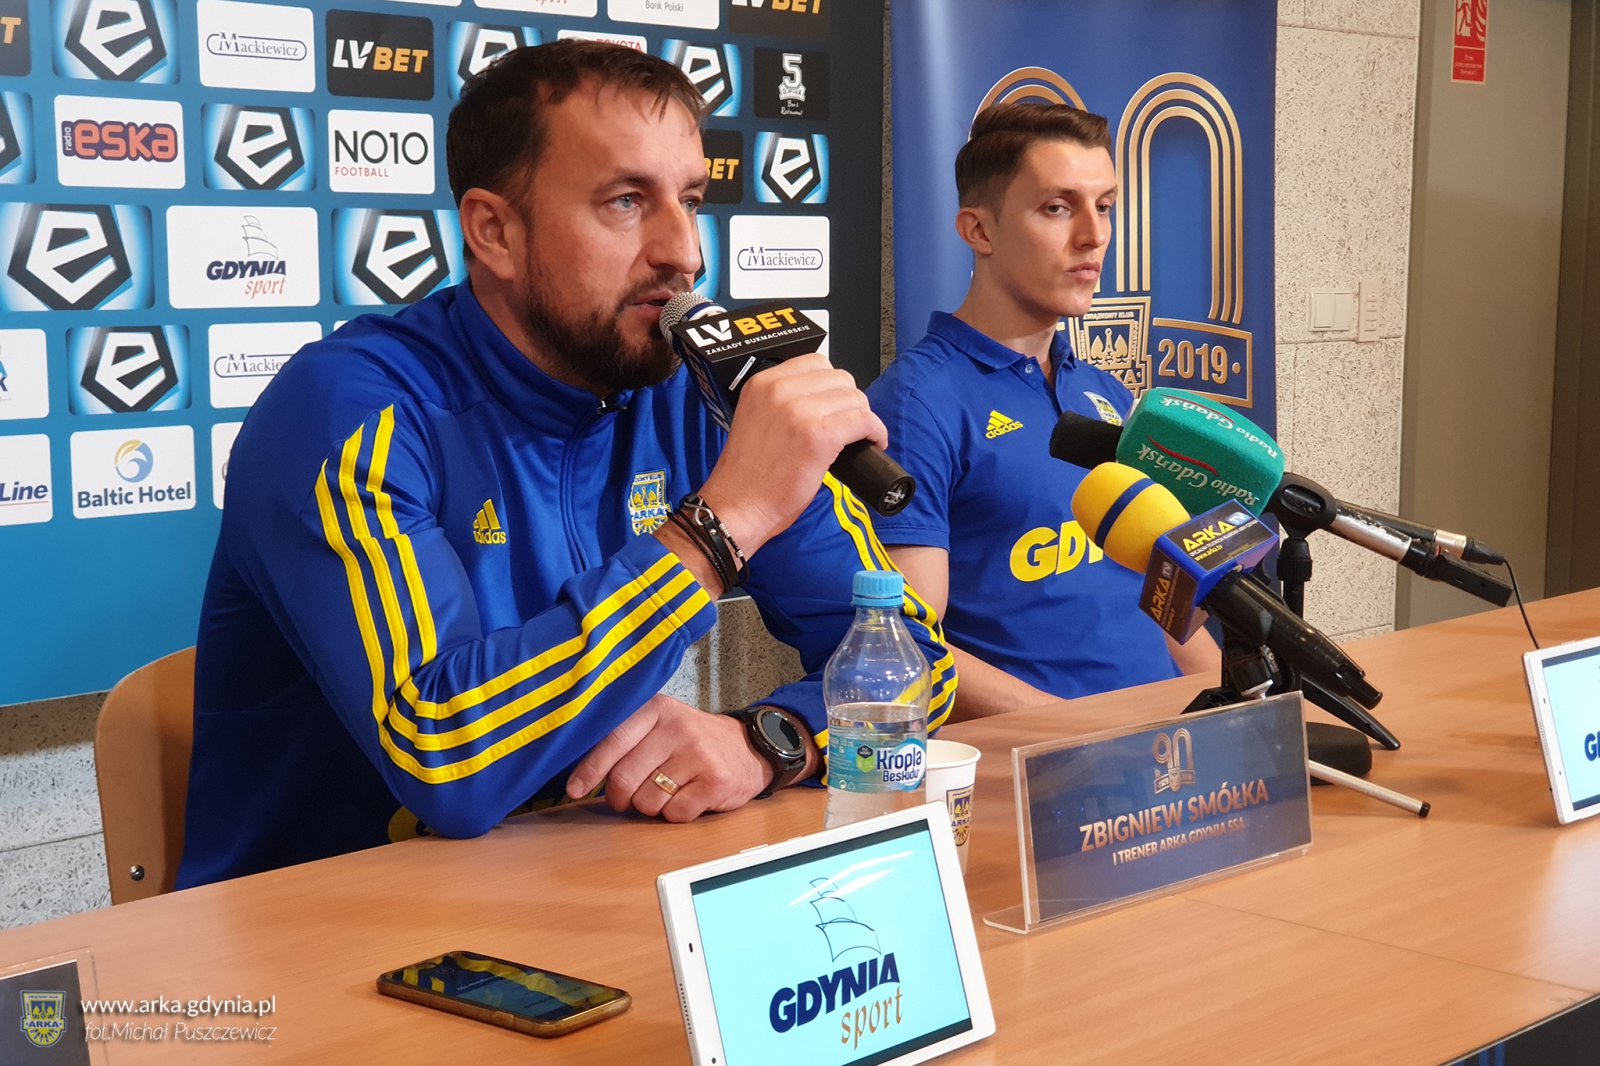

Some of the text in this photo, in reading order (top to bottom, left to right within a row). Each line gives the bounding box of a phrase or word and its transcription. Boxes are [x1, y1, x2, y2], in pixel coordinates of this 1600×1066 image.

[664, 1, 684, 12] Polski
[218, 32, 299, 57] Mackiewicz
[65, 126, 73, 151] radio
[74, 122, 176, 162] eska
[334, 129, 429, 166] NO10
[335, 166, 390, 178] FOOTBALL
[206, 260, 287, 281] GDYNIA
[747, 246, 816, 267] Mackiewicz
[244, 276, 287, 300] sport
[705, 325, 811, 356] ZAKŁADY BUKMACHERSKIE
[225, 353, 287, 374] Mackie
[1158, 338, 1228, 385] 2019
[985, 421, 1024, 439] adidas
[1160, 397, 1278, 459] Radio Gdańsk
[1137, 444, 1260, 506] Radio Gdańsk
[77, 481, 191, 508] Baltic Hotel
[634, 508, 663, 519] ARKA
[1182, 512, 1248, 552] ARKA TV
[1150, 577, 1170, 622] ARKA
[877, 747, 922, 771] Kropla
[1080, 779, 1269, 853] ZBIGNIEW SMÓŁKA
[1118, 841, 1158, 864] TRENER
[1159, 834, 1188, 852] ARKA
[1189, 822, 1226, 843] GDYNIA
[1228, 817, 1245, 833] SSA
[769, 952, 900, 1033] GDYNIA
[841, 985, 903, 1051] sport
